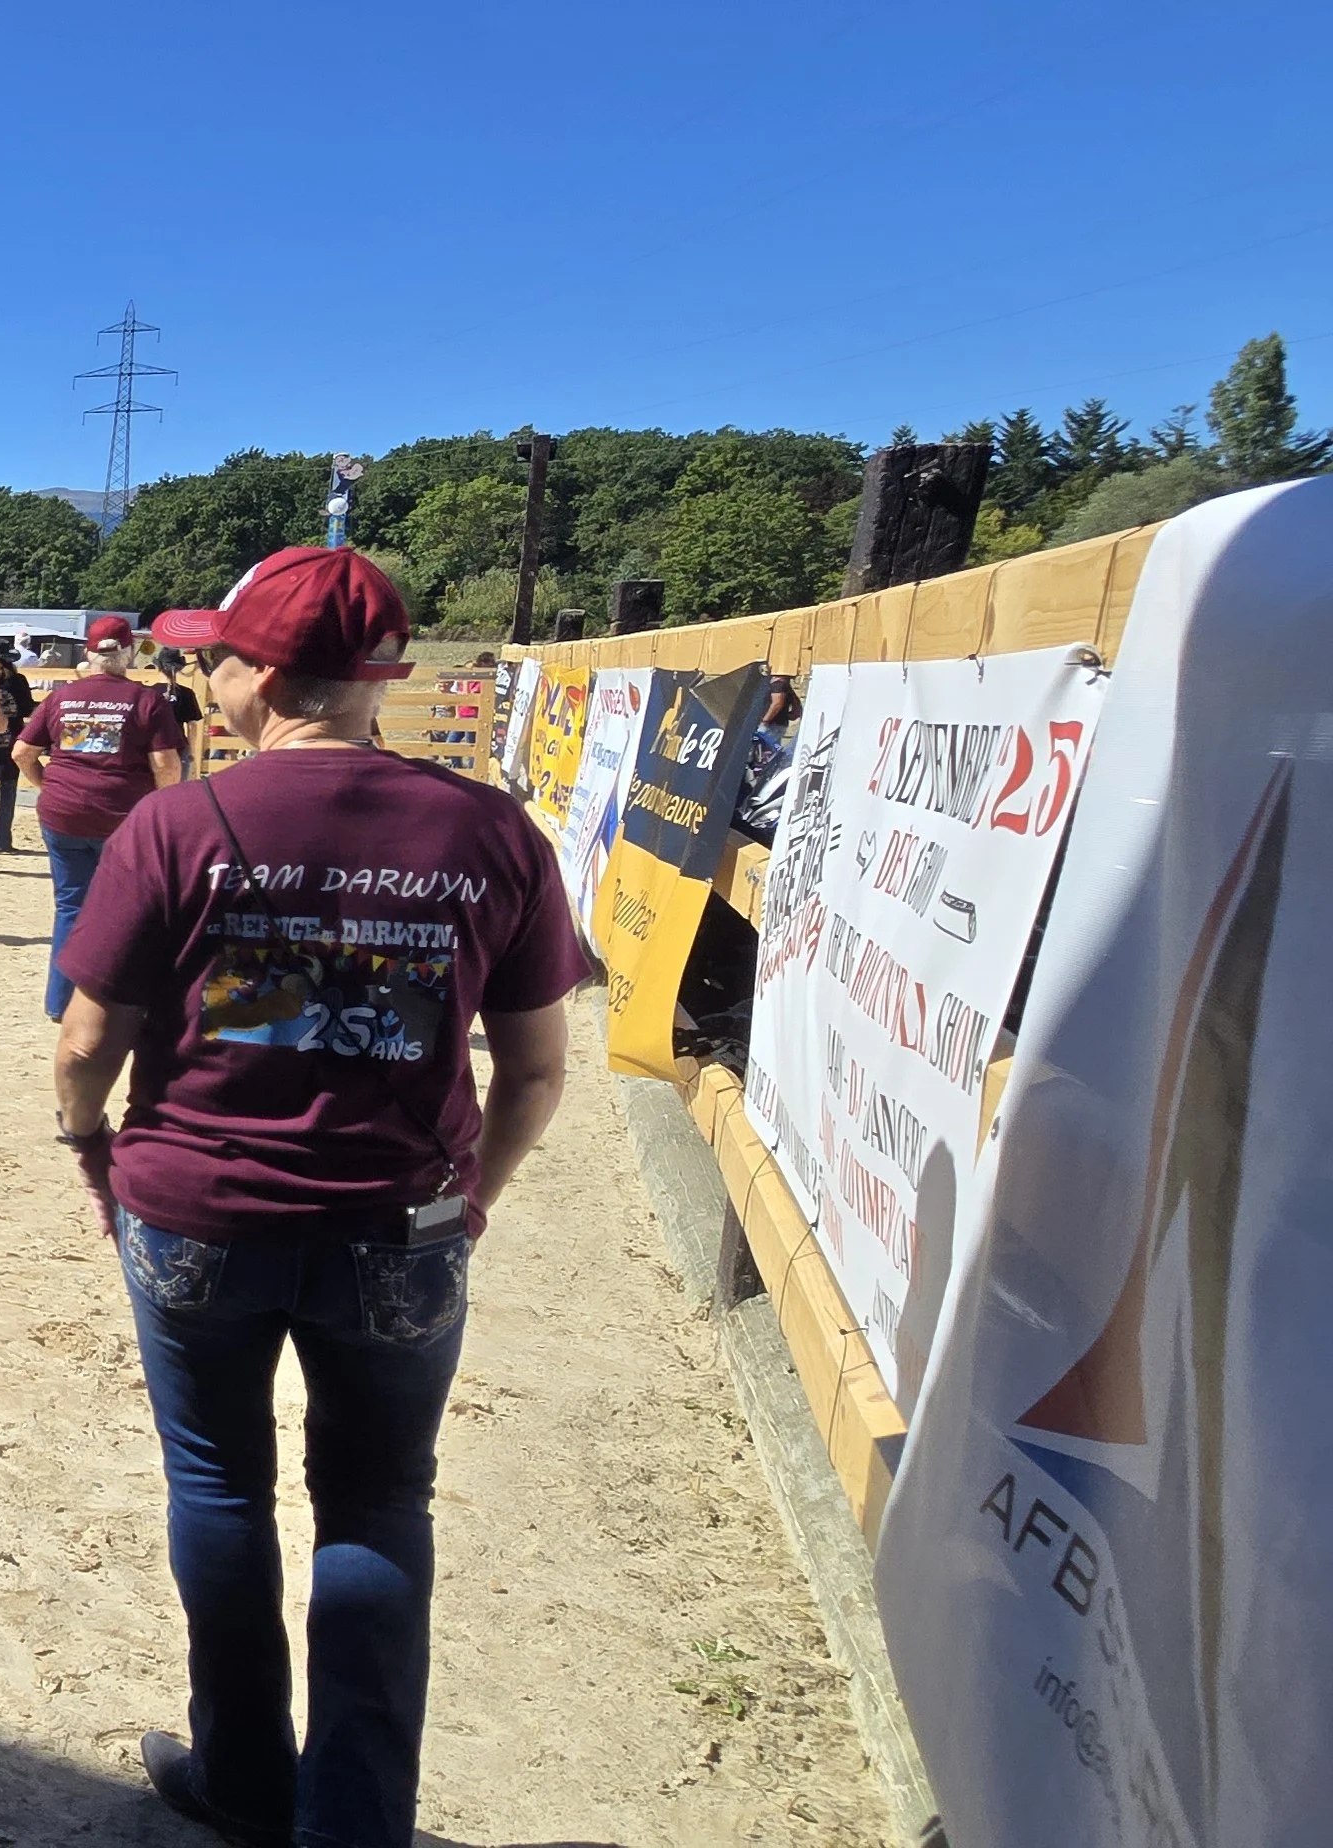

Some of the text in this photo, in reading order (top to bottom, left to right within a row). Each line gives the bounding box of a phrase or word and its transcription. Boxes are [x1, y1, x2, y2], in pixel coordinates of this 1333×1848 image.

[208, 863, 487, 904] TEAM DARWYN
[341, 919, 454, 948] DARWYN
[296, 1003, 377, 1056] 25
[370, 1041, 423, 1062] ANS
[979, 1472, 1101, 1617] AFB
